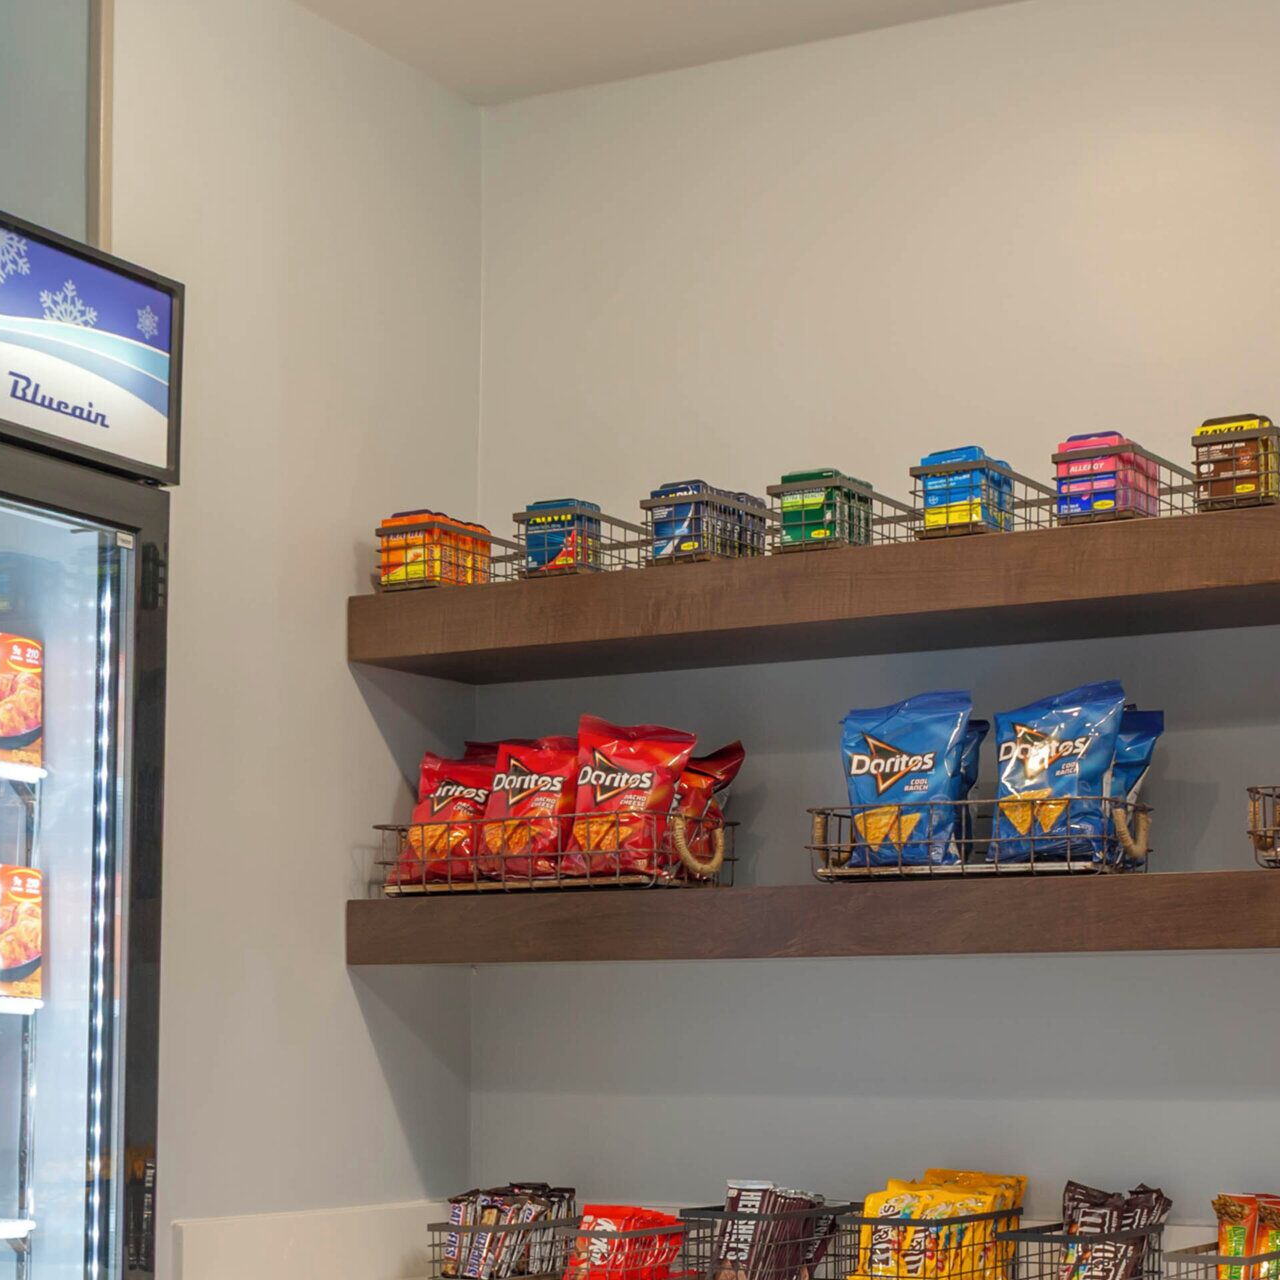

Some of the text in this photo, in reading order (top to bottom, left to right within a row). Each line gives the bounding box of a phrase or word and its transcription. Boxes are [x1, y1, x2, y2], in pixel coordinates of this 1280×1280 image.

[8, 371, 110, 428] Blueair
[850, 752, 937, 775] Doritos
[493, 773, 565, 792] Doritos
[578, 766, 654, 790] Doritos
[904, 784, 929, 792] RANCH
[909, 778, 929, 786] COOL
